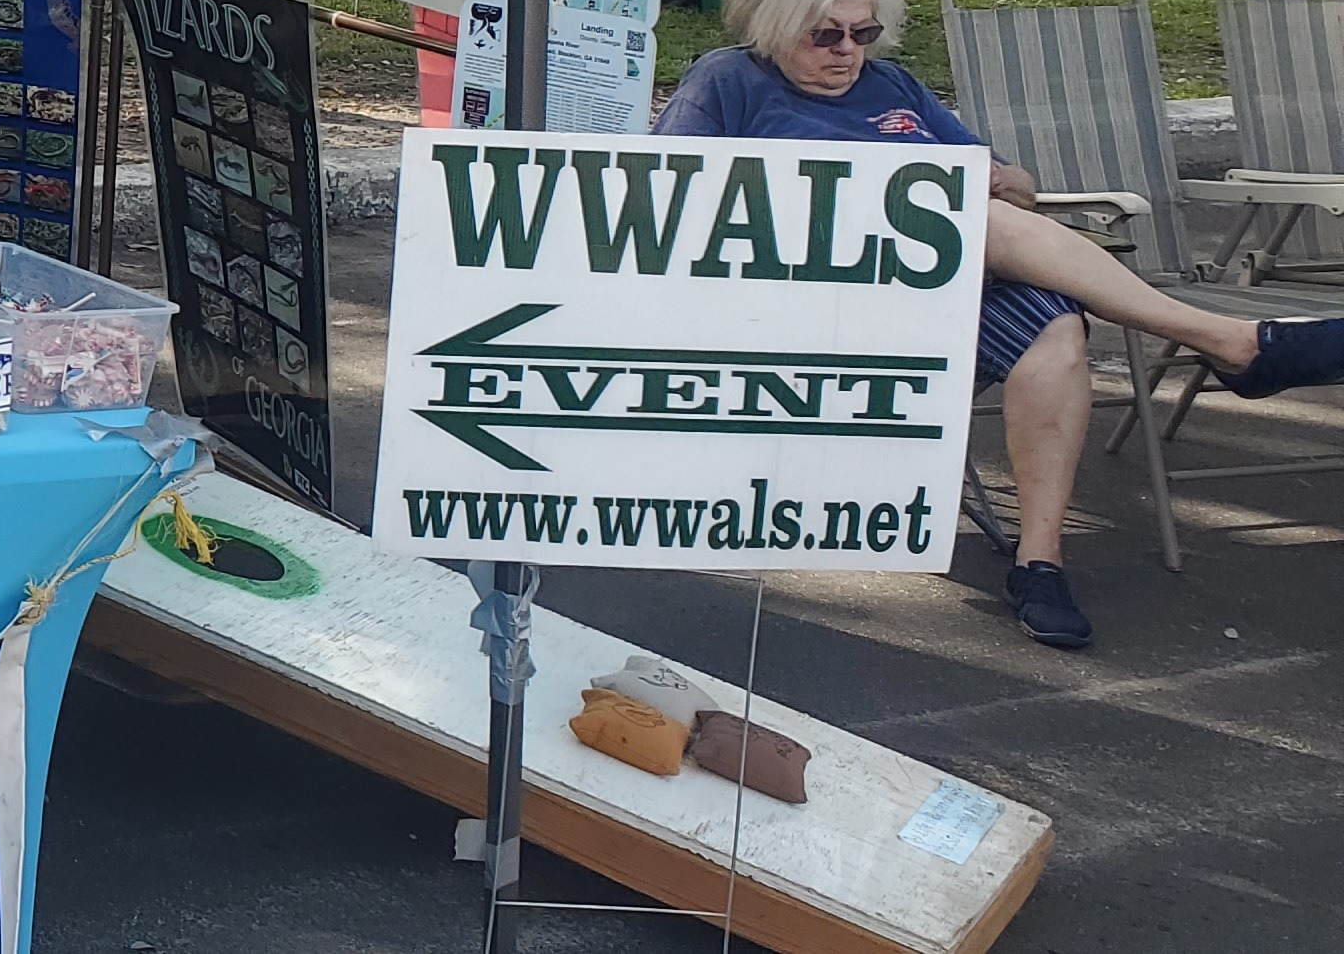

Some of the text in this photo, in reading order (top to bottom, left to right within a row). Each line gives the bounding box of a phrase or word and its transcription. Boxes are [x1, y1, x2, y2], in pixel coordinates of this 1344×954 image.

[580, 22, 615, 38] Landing
[432, 144, 965, 290] WWALS
[245, 375, 328, 477] GEORGIA
[427, 361, 929, 421] EVENT
[402, 478, 932, 555] www.wwals.net
